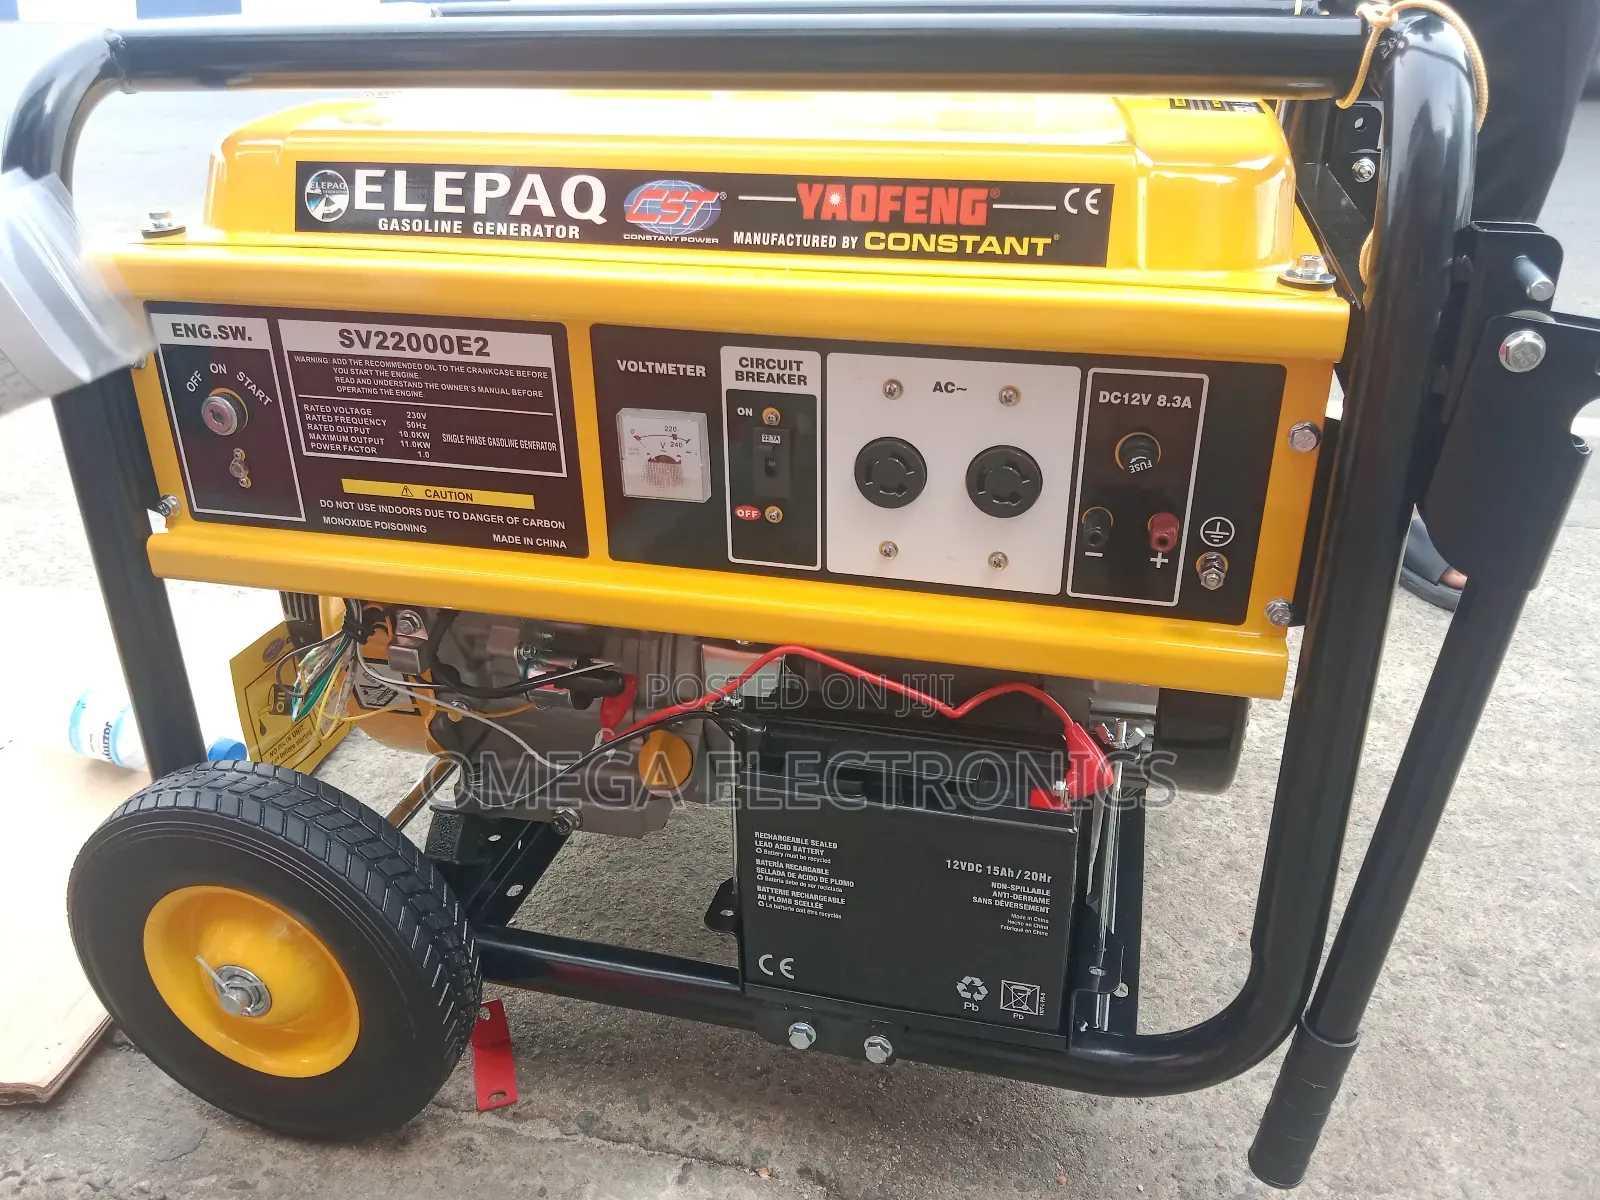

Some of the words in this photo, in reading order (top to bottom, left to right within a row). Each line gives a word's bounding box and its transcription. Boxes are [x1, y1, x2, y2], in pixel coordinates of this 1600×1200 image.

[354, 169, 607, 225] ELEPAQ
[797, 183, 989, 225] YAOFENG
[1063, 187, 1102, 215] CE
[625, 189, 720, 225] CST
[378, 216, 463, 234] GASOLINE
[473, 220, 581, 239] GENERATOR
[623, 234, 680, 242] CONSTANT
[681, 236, 719, 244] POWER
[733, 231, 837, 248] MANUFACTURED
[841, 235, 858, 249] BY
[864, 231, 1052, 257] CONSTANT
[171, 322, 253, 342] ENG.SW.
[338, 328, 490, 357] SV22000E2
[209, 363, 227, 374] ON
[332, 358, 348, 366] ADD
[348, 358, 363, 367] THE
[364, 360, 423, 371] RECOMMENDED
[424, 363, 437, 371] OIL
[437, 364, 449, 372] TO
[449, 365, 465, 374] THE
[466, 366, 515, 377] CRANKCASE
[516, 370, 549, 379] BEFORE
[616, 359, 707, 378] VOLTMETER
[738, 356, 804, 372] CIRCUIT
[186, 370, 203, 393] OFF
[333, 367, 349, 375] YOU
[350, 368, 374, 377] START
[374, 370, 390, 378] THE
[391, 371, 421, 380] ENGINE.
[734, 370, 808, 386] BREAKER
[236, 371, 273, 406] START
[334, 377, 355, 385] READ
[356, 379, 372, 387] AND
[373, 380, 423, 390] UNDERSTAND
[424, 382, 440, 391] THE
[440, 383, 477, 394] OWNER'S
[477, 387, 511, 397] MANUAL
[511, 389, 544, 399] BEFORE
[336, 386, 379, 396] OPERATING
[380, 389, 395, 397] THE
[1099, 391, 1152, 406] DC12V
[1156, 395, 1192, 408] 8.3A
[303, 404, 332, 414] RATED
[333, 407, 373, 417] VOLTAGE
[406, 411, 427, 421] 230V
[737, 407, 753, 417] ON
[305, 414, 334, 424] RATED
[334, 416, 387, 428] FREQUENCY
[406, 421, 427, 431] 50Hz
[664, 425, 677, 433] 220
[307, 423, 335, 433] RATED
[336, 426, 371, 436] OUTPUT
[398, 430, 430, 440] 10.0KW
[308, 433, 350, 443] MAXIMUM
[350, 436, 385, 446] OUTPUT
[400, 440, 431, 450] 11.0KW
[441, 433, 465, 444] SINGLE
[465, 435, 487, 446] PHASE
[487, 437, 519, 449] GASOLINE
[519, 440, 558, 452] GENERATOR
[670, 441, 683, 449] 240
[310, 442, 342, 452] POWER
[343, 445, 378, 455] FACTOR
[417, 450, 431, 459] 1.0
[1128, 459, 1153, 474] FUSE
[424, 488, 474, 502] CAUTION
[319, 499, 334, 508] DO
[336, 501, 354, 510] NOT
[357, 503, 377, 513] USE
[378, 504, 422, 517] INDOORS
[424, 508, 445, 519] DUE
[446, 510, 460, 520] TO
[462, 512, 505, 524] DANGER
[506, 516, 520, 525] OF
[522, 517, 566, 530] CARBON
[736, 509, 758, 518] OFF
[322, 516, 373, 529] MONOXIDE
[374, 520, 428, 534] POISONING
[492, 533, 522, 546] MADE
[523, 537, 535, 546] IN
[535, 538, 568, 549] CHINA
[754, 831, 809, 845] RECHARGEABLE
[810, 839, 838, 849] SEALED
[755, 840, 773, 848] LEAD
[774, 843, 791, 851] ACID
[792, 846, 824, 856] BATTERY
[763, 849, 784, 858] Battery
[946, 859, 983, 874] 12VDC
[756, 867, 786, 877] SELLADA
[787, 871, 797, 879] DE
[797, 873, 818, 882] ACIDO
[820, 876, 829, 884] DE
[830, 878, 855, 888] PLOMO
[756, 885, 789, 896] BATTERIE
[791, 890, 846, 905] RECHARGEABLE
[991, 881, 1051, 897] NON-SPILLABLE
[992, 890, 1051, 905] ANTI-DERRAME
[757, 893, 767, 901] AU
[768, 895, 792, 905] PLOMB
[972, 896, 993, 905] SANS
[963, 1001, 980, 1012] Pb
[1012, 1012, 1024, 1020] Pb
